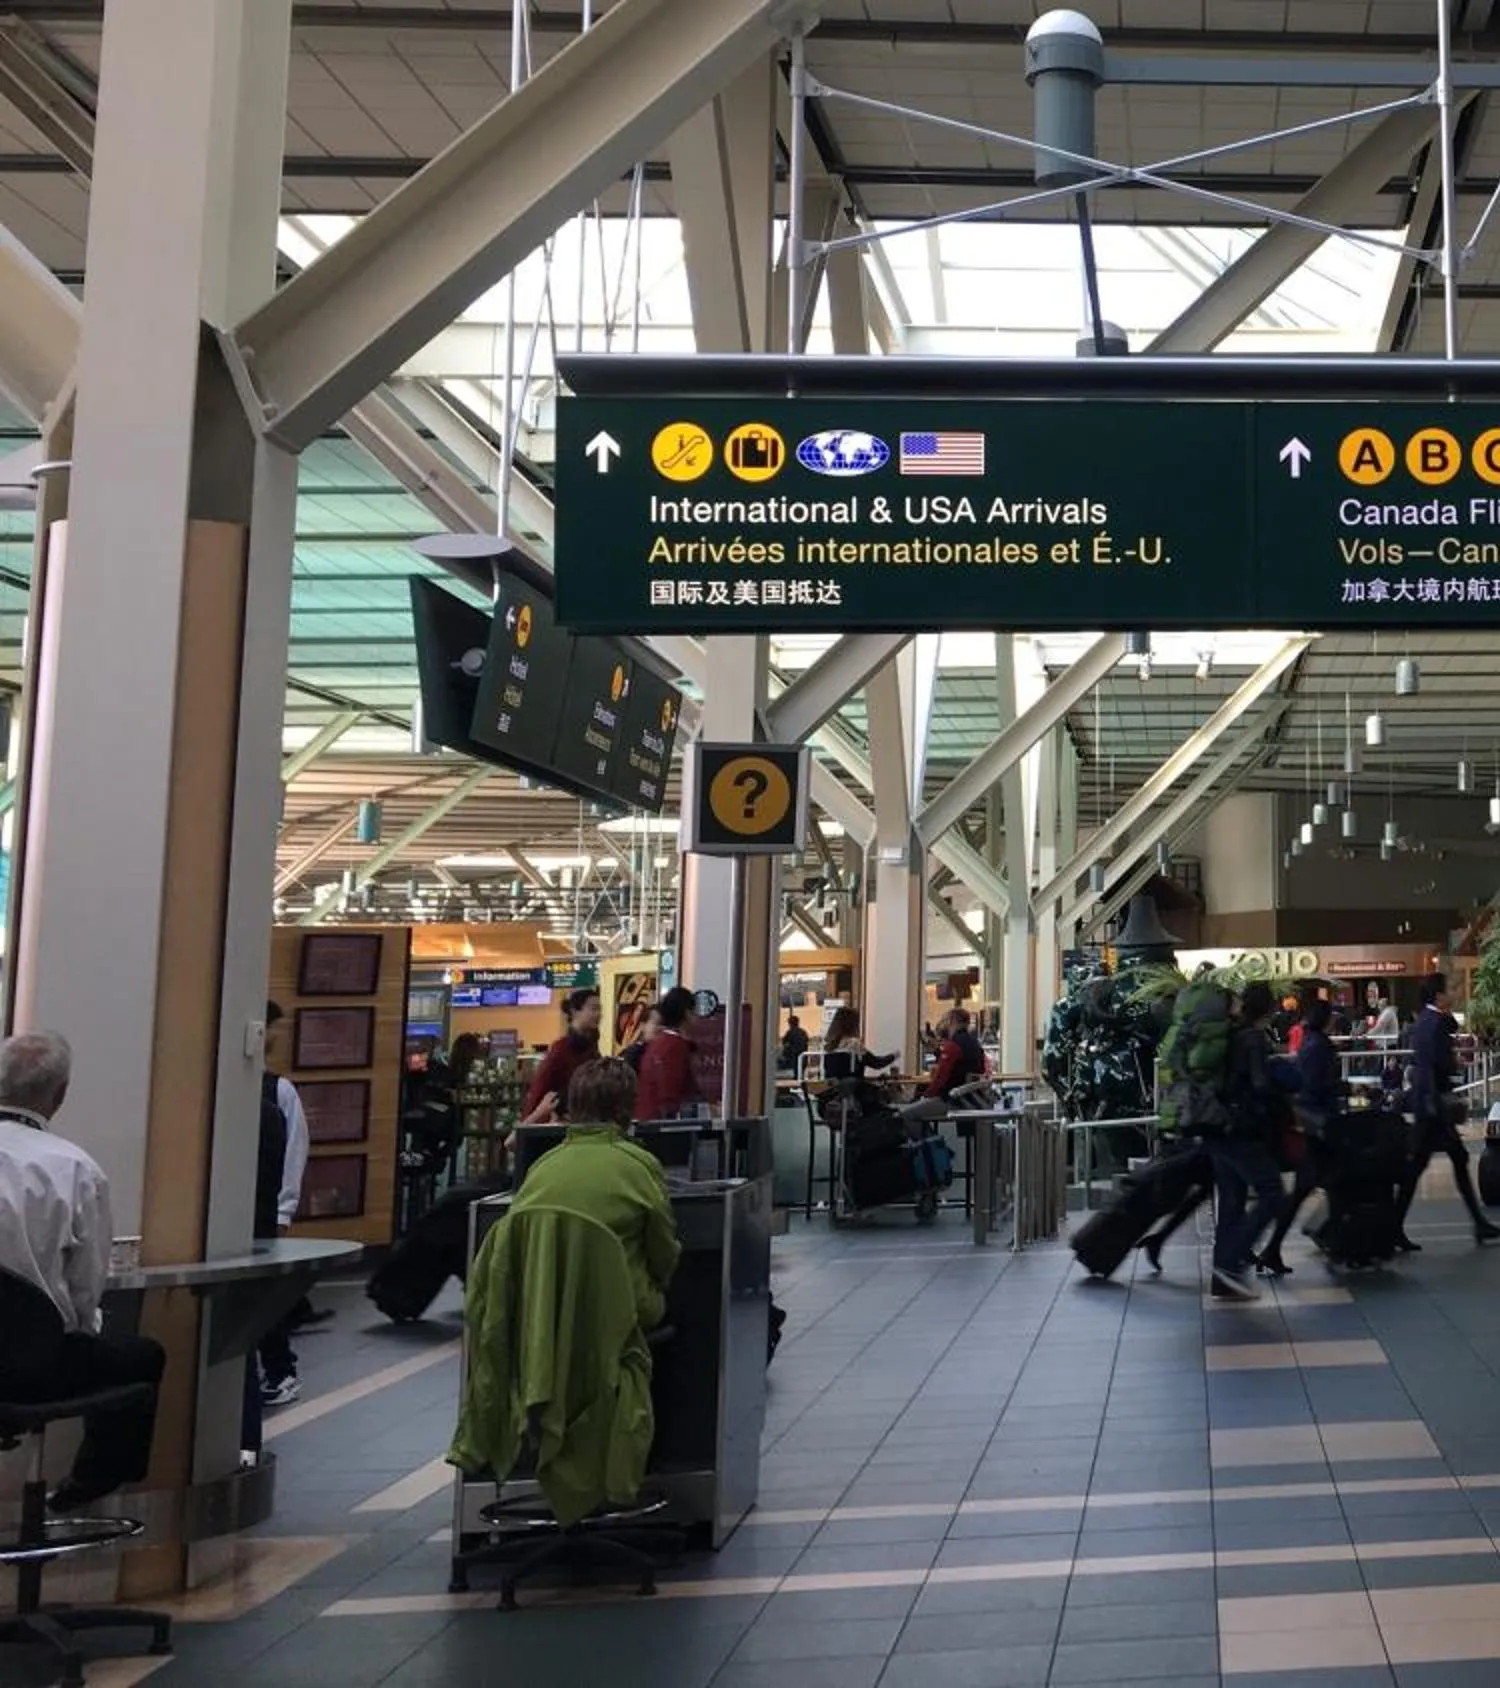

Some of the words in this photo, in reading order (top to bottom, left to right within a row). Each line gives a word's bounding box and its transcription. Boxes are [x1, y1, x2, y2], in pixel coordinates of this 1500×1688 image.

[1350, 439, 1385, 474] A
[1420, 439, 1450, 474] B
[650, 495, 858, 524] International
[869, 495, 894, 524] &
[904, 495, 977, 525] USA
[985, 496, 1108, 525] Arrivals
[1339, 498, 1459, 526] Canada
[647, 535, 785, 564] Arrivées
[798, 536, 1039, 564] internationales
[1050, 538, 1081, 564] et
[1092, 530, 1172, 565] É.-U.
[650, 579, 842, 606] 国际及美国抵达
